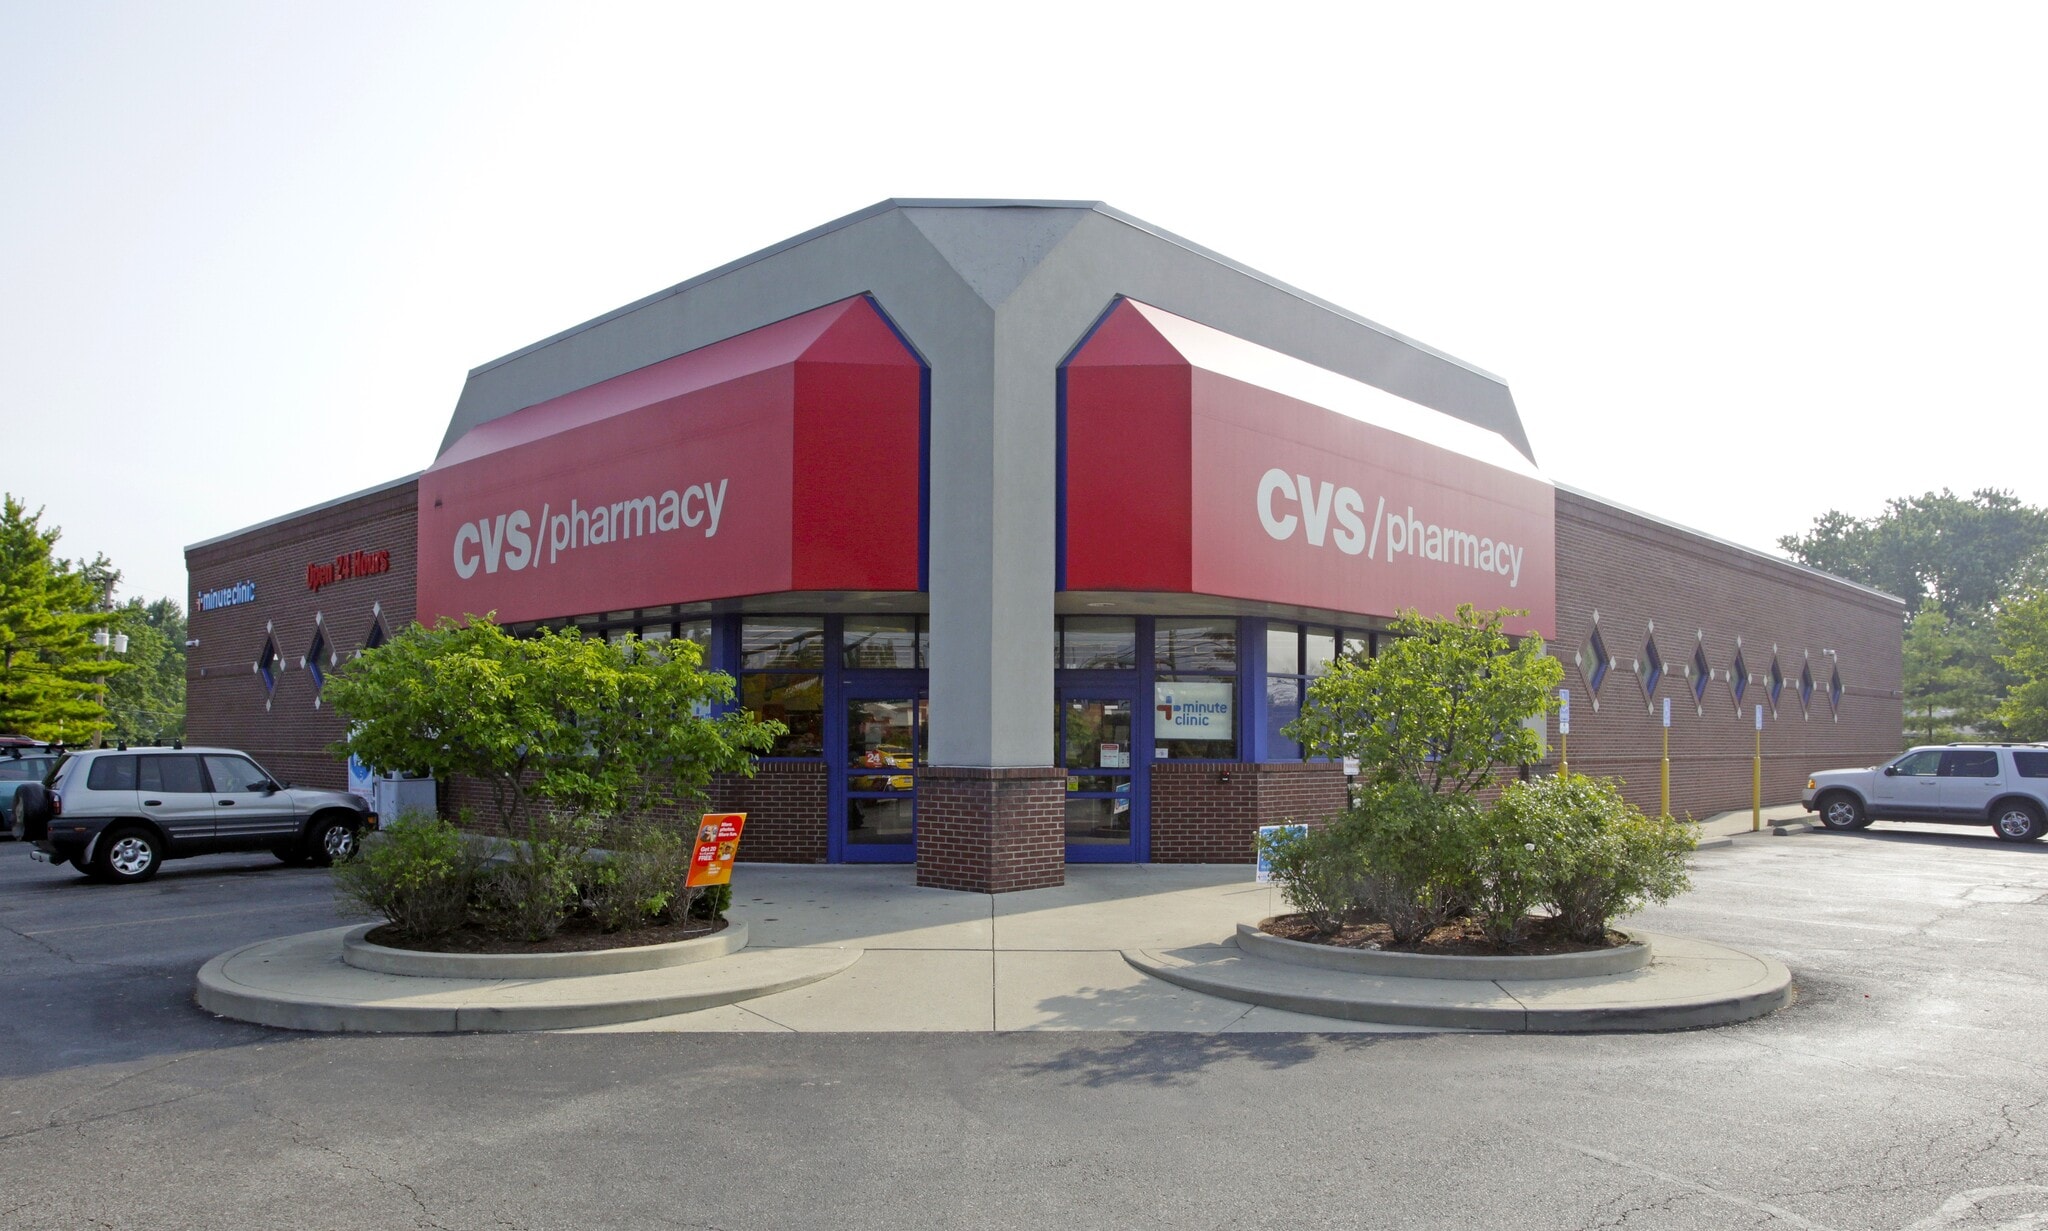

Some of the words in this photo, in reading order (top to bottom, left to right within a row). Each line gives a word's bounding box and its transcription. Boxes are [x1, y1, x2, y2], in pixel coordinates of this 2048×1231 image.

[453, 478, 729, 580] CVS/pharmacy
[1256, 467, 1524, 588] CVS/pharmacy
[307, 563, 334, 592] Open
[336, 554, 351, 581] 24
[354, 550, 389, 577] Hours
[1175, 713, 1210, 726] clinic
[1182, 701, 1227, 713] minute
[867, 753, 880, 763] 24
